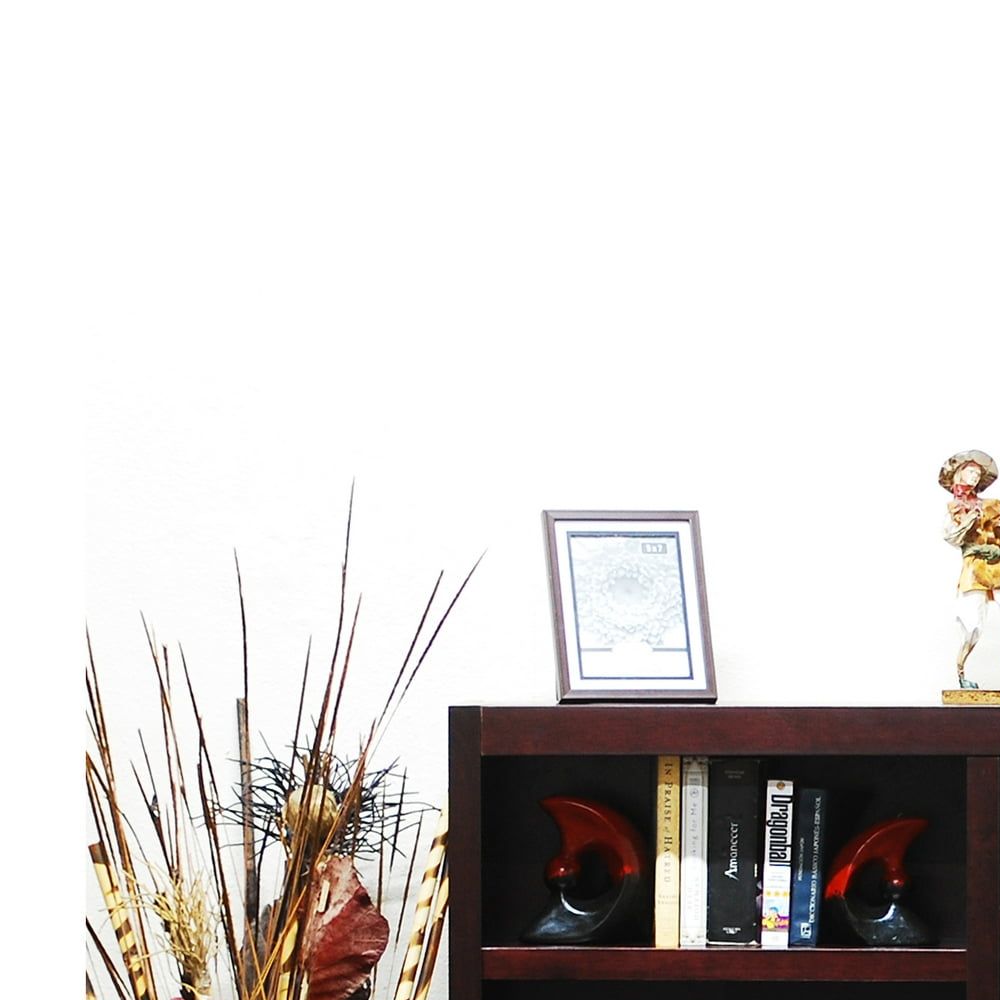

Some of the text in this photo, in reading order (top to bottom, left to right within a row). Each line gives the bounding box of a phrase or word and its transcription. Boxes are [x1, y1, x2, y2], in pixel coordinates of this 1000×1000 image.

[664, 763, 673, 775] IN
[663, 781, 673, 822] PRAISE
[723, 822, 740, 881] Amanecer
[809, 880, 817, 923] DICCIONARIO
